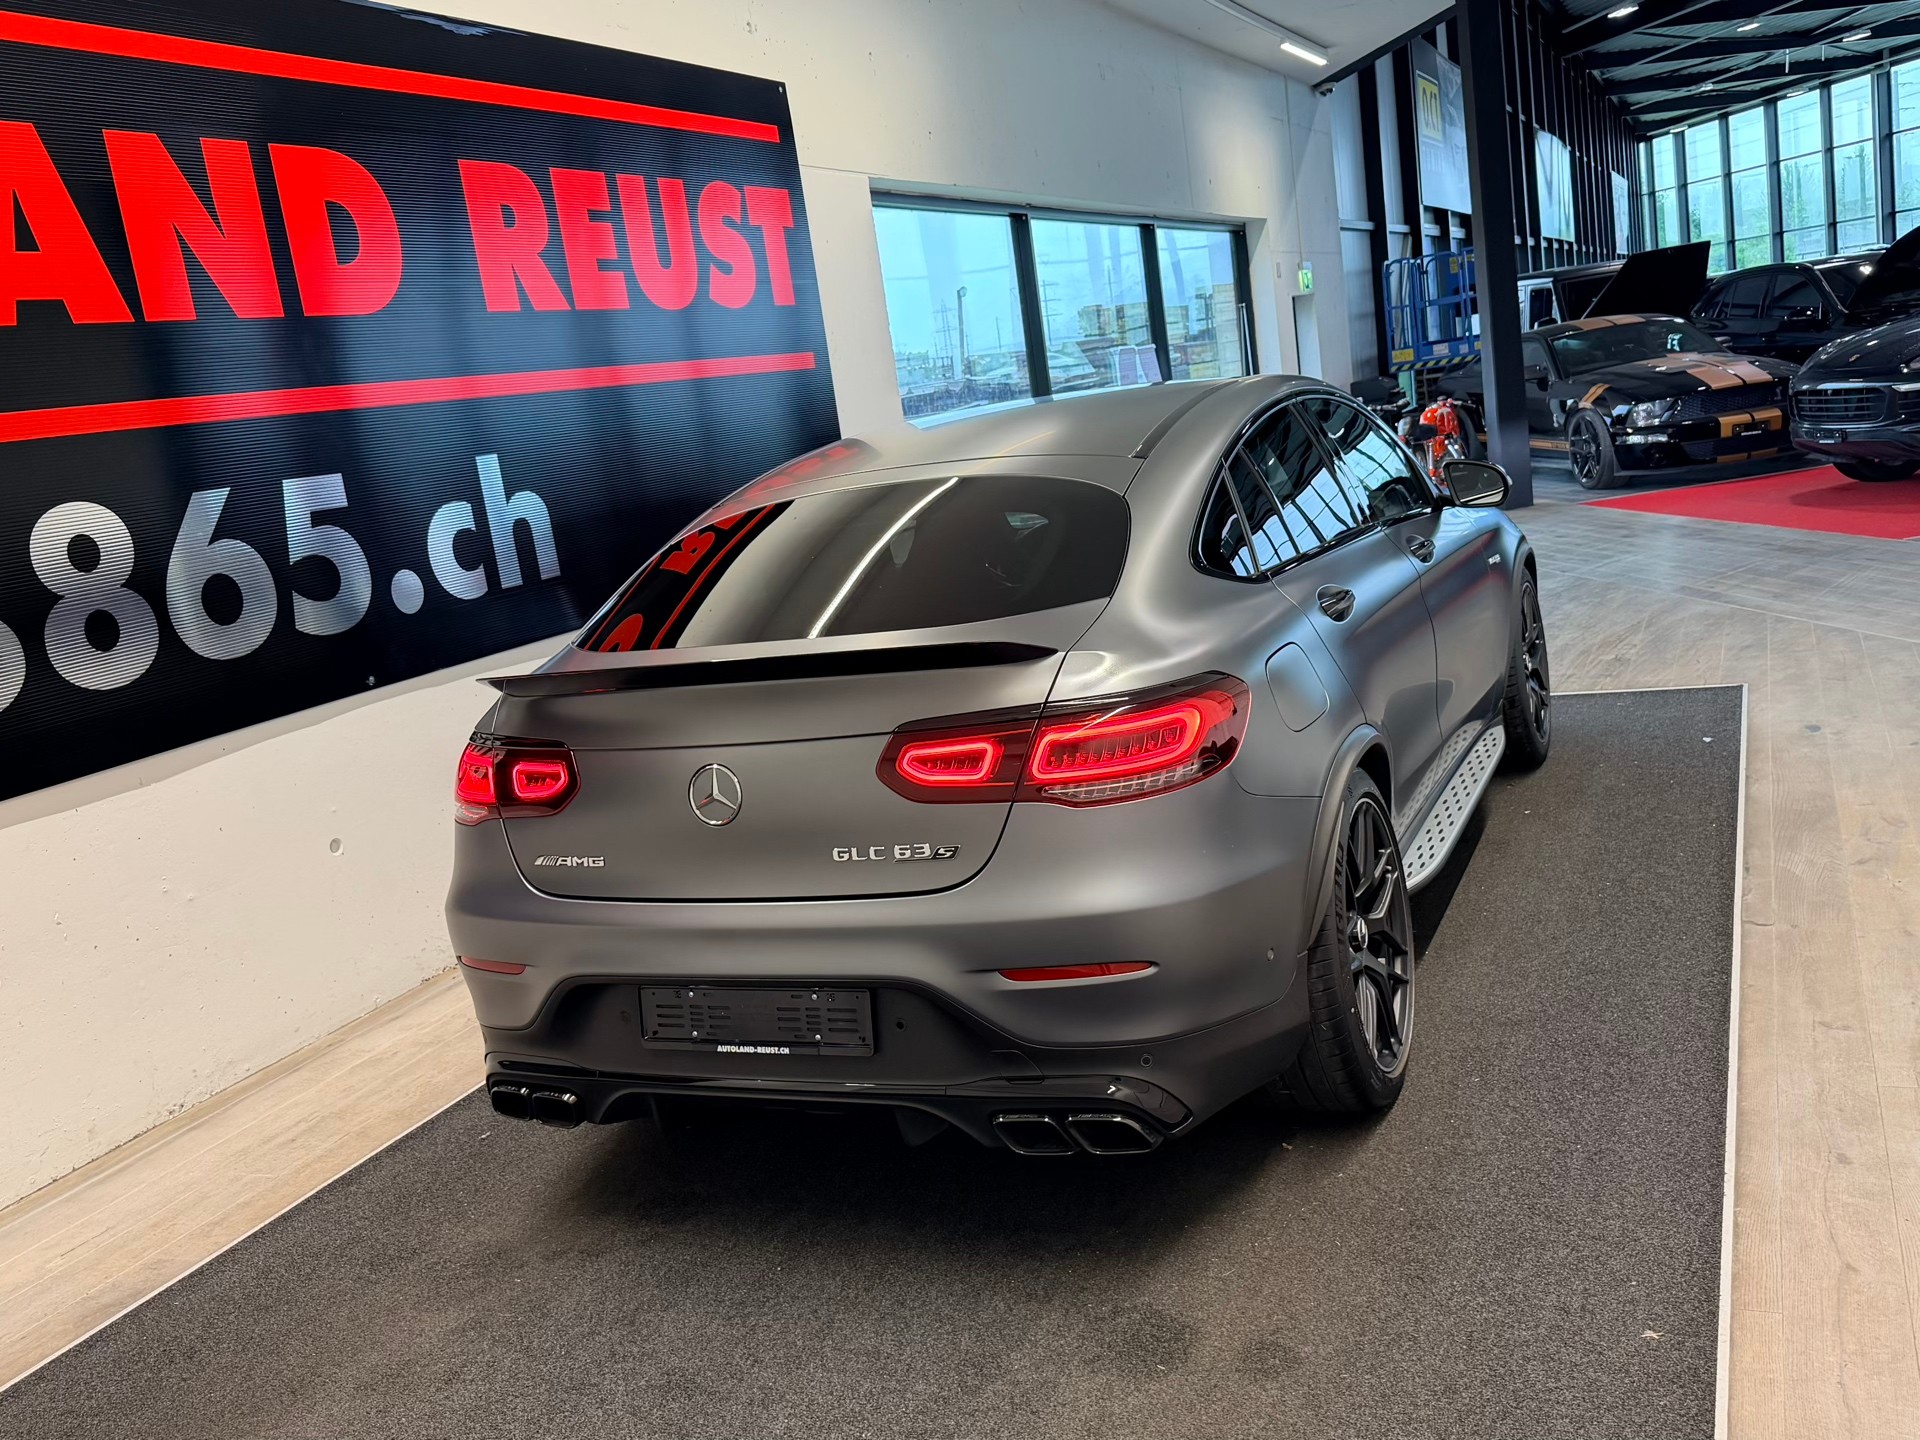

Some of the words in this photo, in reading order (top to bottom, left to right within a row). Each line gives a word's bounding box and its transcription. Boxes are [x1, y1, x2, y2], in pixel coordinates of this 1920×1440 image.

[0, 121, 402, 326] AND
[457, 159, 796, 312] REUST
[0, 453, 561, 712] 865.ch
[832, 846, 886, 861] GLC
[556, 856, 605, 867] AMG
[717, 1045, 790, 1054] AUTOLAND-REUST.CH
